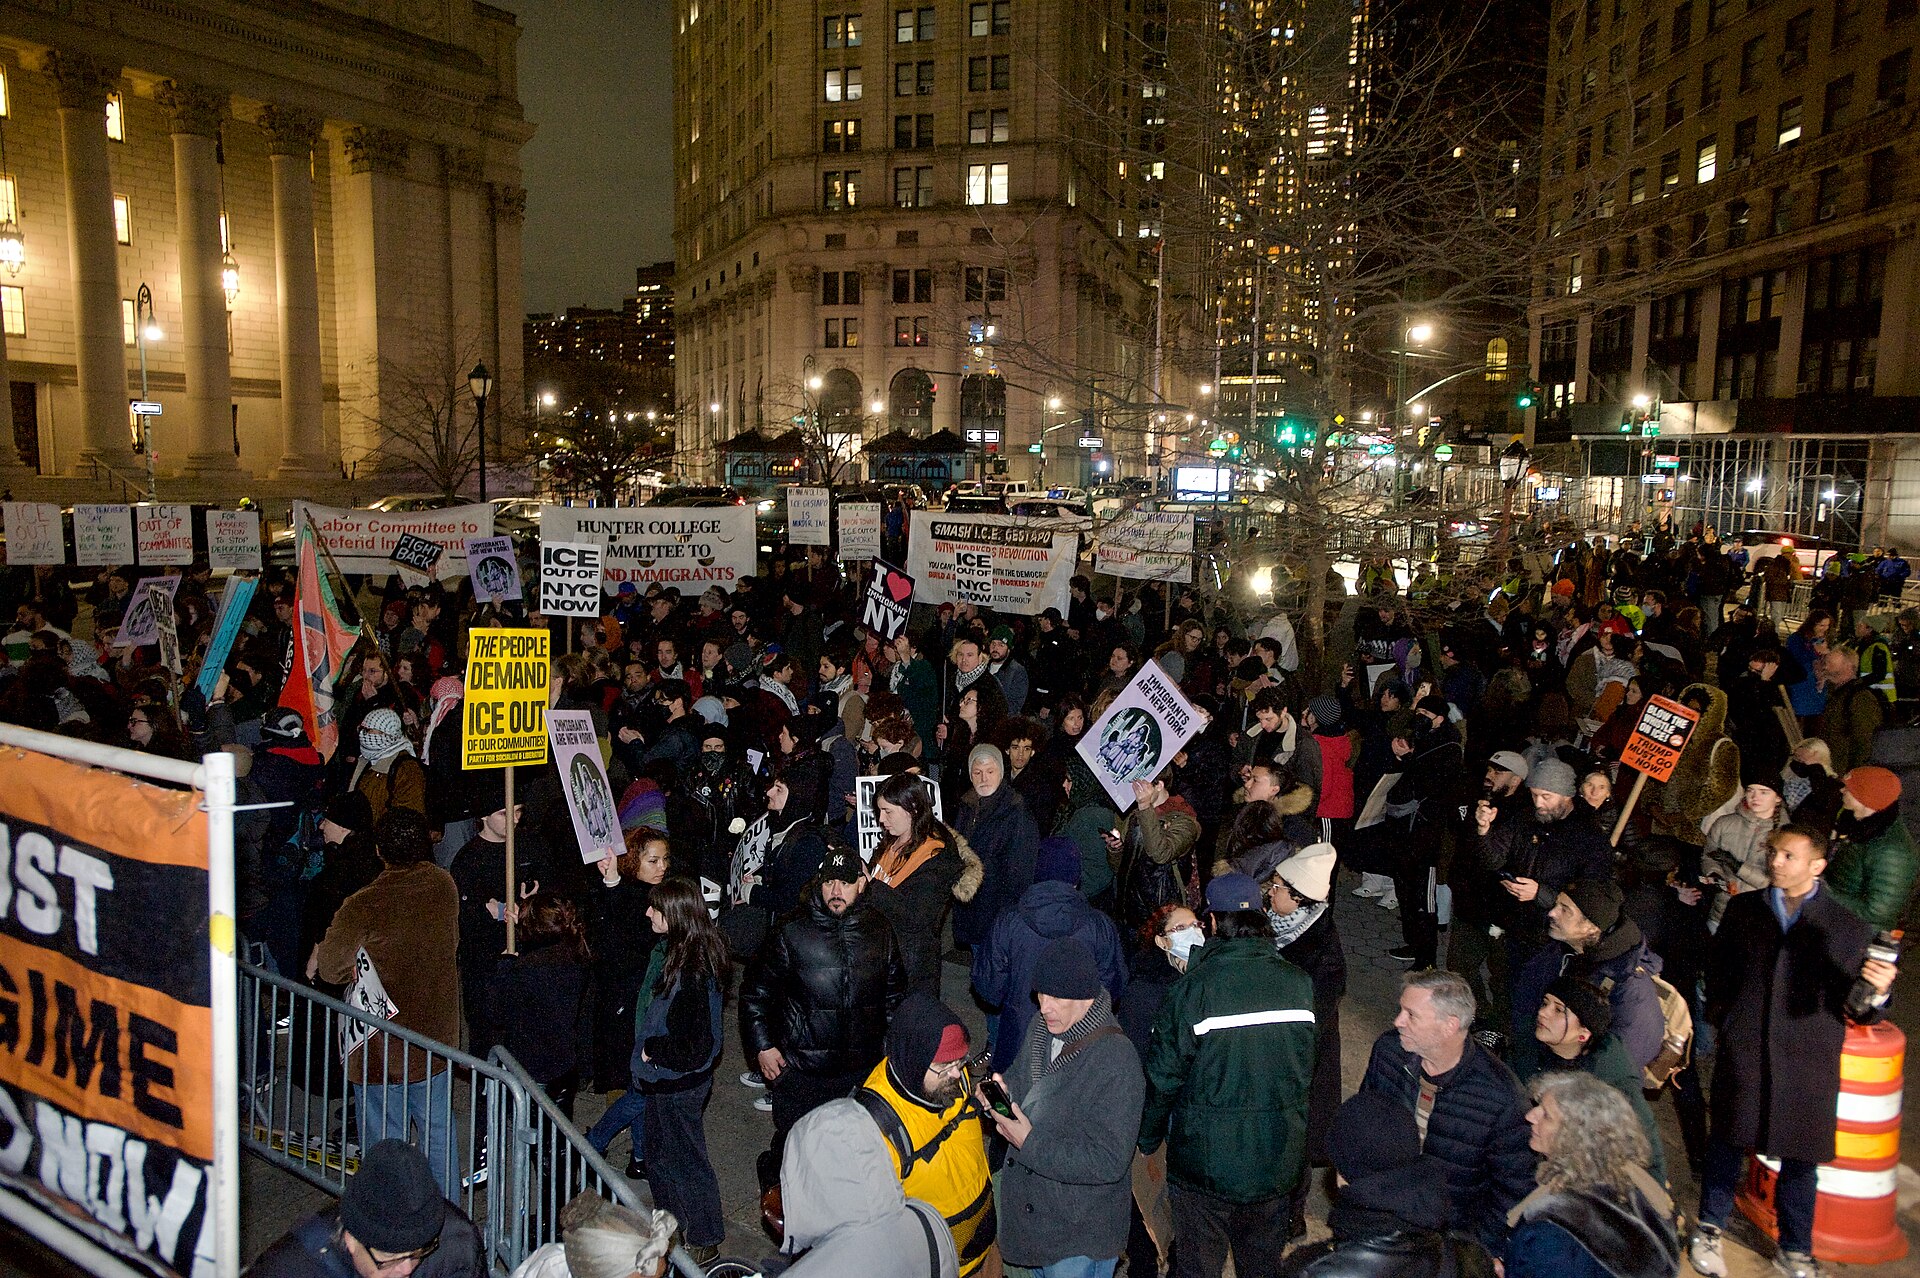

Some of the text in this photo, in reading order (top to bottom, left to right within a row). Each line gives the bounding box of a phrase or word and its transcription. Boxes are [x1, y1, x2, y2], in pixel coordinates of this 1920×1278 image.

[15, 504, 49, 525] ICE
[147, 506, 178, 519] ICE
[801, 511, 810, 519] IS
[870, 504, 879, 512] IS
[221, 512, 237, 520] FOR
[139, 518, 182, 532] OUT OF
[218, 528, 246, 536] ACTION
[317, 518, 479, 534] abor Committee to
[577, 520, 721, 535] HUNTER COLLEGE
[841, 527, 857, 535] ICE
[857, 527, 869, 535] OUT
[16, 525, 48, 541] OUT
[153, 532, 171, 540] OUR
[229, 536, 249, 544] STOP
[934, 523, 972, 538] SMASH
[1005, 528, 1050, 544] GESTAPO
[139, 537, 194, 552] COMMUNITIES
[316, 536, 465, 551] Defend Imrant
[400, 535, 442, 557] FIGHT
[470, 539, 506, 549] IMMIGRANTS
[480, 547, 492, 555] NEW
[606, 544, 711, 558] MMITTEE TO
[935, 541, 955, 554] WITH
[998, 546, 1049, 561] REVOLUTION
[396, 547, 434, 569] BACK
[543, 547, 599, 568] ICE
[956, 552, 992, 568] ICE
[543, 568, 575, 578] OUT
[576, 569, 598, 579] OF
[631, 567, 735, 583] IMMIGRANTS
[870, 562, 888, 594] I
[928, 571, 945, 579] BUILD
[956, 567, 991, 577] OUT OF
[1005, 568, 1015, 577] THE
[543, 582, 599, 598] NYC
[956, 579, 992, 592] NYC
[999, 578, 1030, 587] WORKERS
[866, 587, 909, 618] IMMIGRANT
[957, 591, 992, 603] NOW
[1009, 595, 1032, 604] GROUP
[542, 599, 598, 612] NOW
[863, 597, 905, 641] NY
[474, 635, 547, 659] THE PEOPLE
[470, 661, 547, 690] DEMAND
[1146, 673, 1190, 726] IMMIGRANTS
[1136, 678, 1187, 739] ARE NEW YORK!
[468, 700, 546, 736] ICE OUT
[1642, 713, 1677, 735] WHISTLE
[1646, 704, 1672, 722] BLOW
[1670, 715, 1690, 730] THE
[554, 719, 589, 732] IMMIGRANTS
[1638, 722, 1671, 743] ON ICE!
[467, 734, 546, 752] OF OUR COMMUNITIES!
[555, 732, 595, 746] ARE NEW YORK!
[1636, 736, 1673, 758] TRUMP
[468, 753, 485, 764] PARTY
[485, 753, 496, 762] FOR
[1628, 743, 1673, 769] MUST GO
[1635, 759, 1664, 776] NOW!
[0, 822, 114, 957] ST
